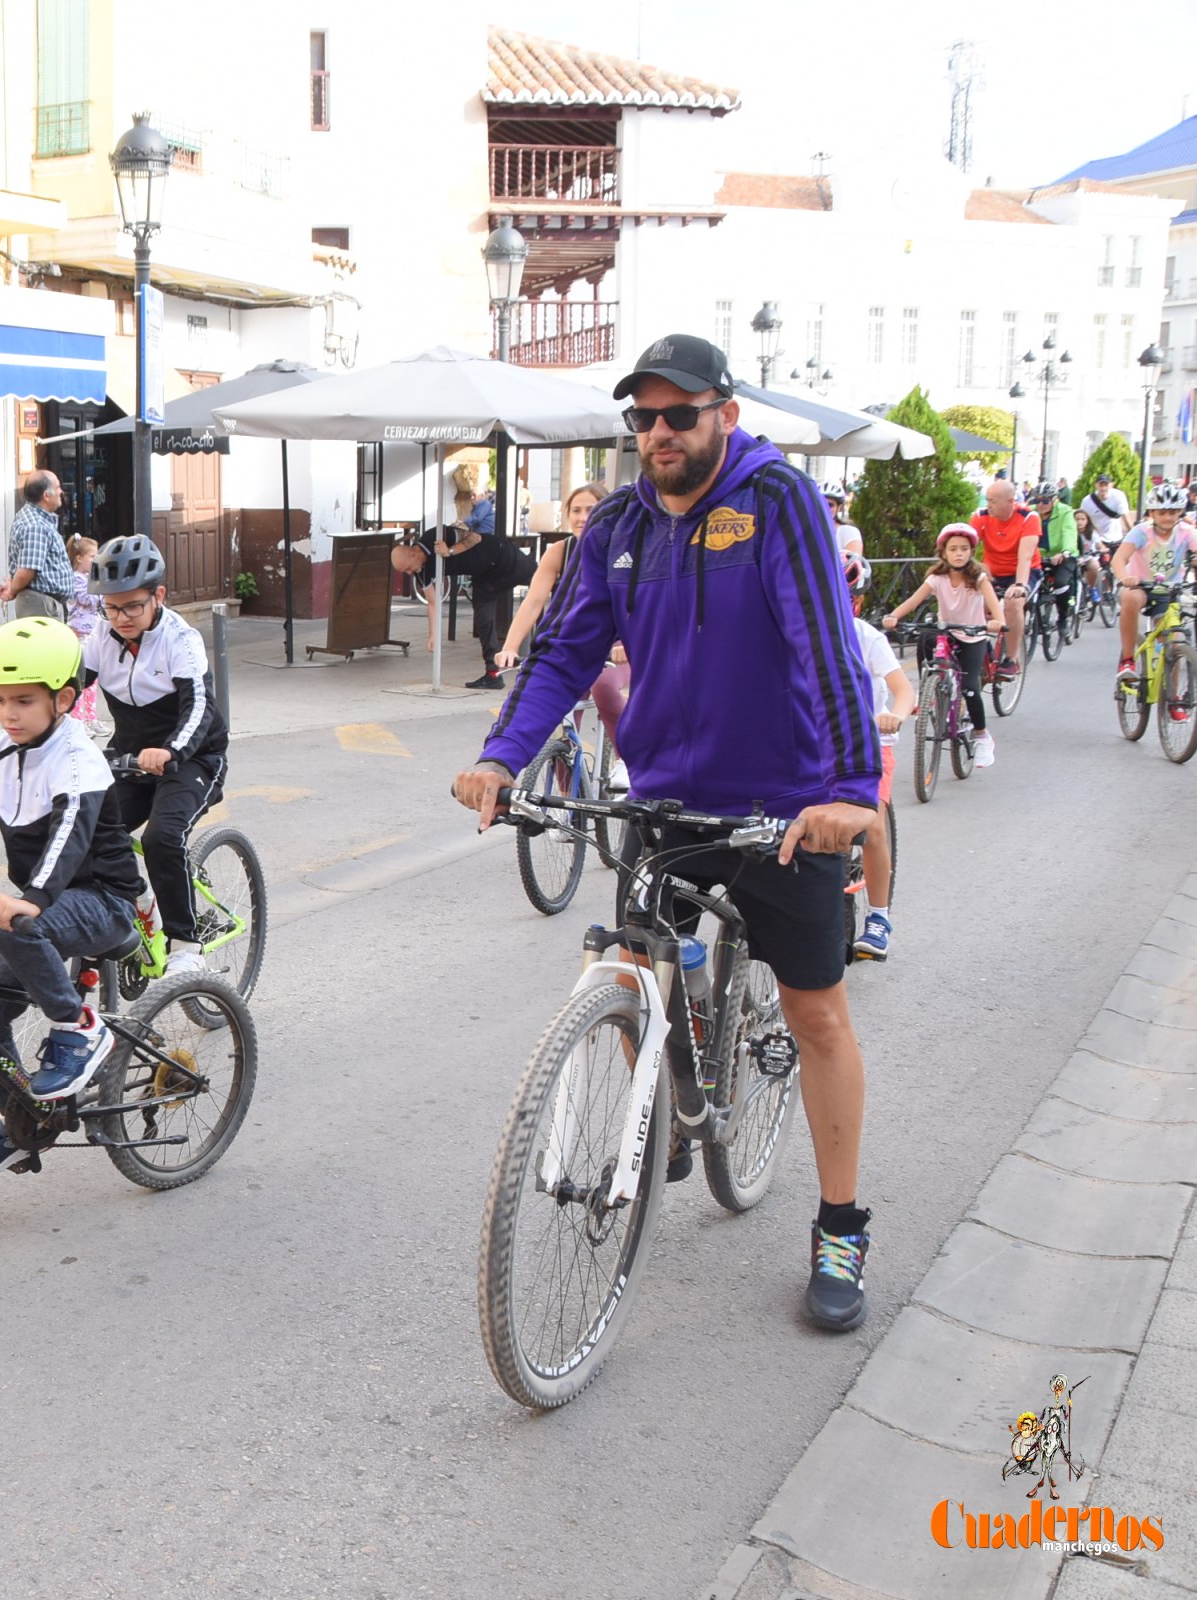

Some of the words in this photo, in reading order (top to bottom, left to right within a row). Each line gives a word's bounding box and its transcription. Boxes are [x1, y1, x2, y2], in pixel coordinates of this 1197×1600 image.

[153, 429, 163, 449] el
[384, 425, 428, 439] CERVEZAS
[429, 426, 483, 441] ALHAMBRA
[705, 522, 749, 538] AKERS
[631, 1103, 651, 1173] SLIDE
